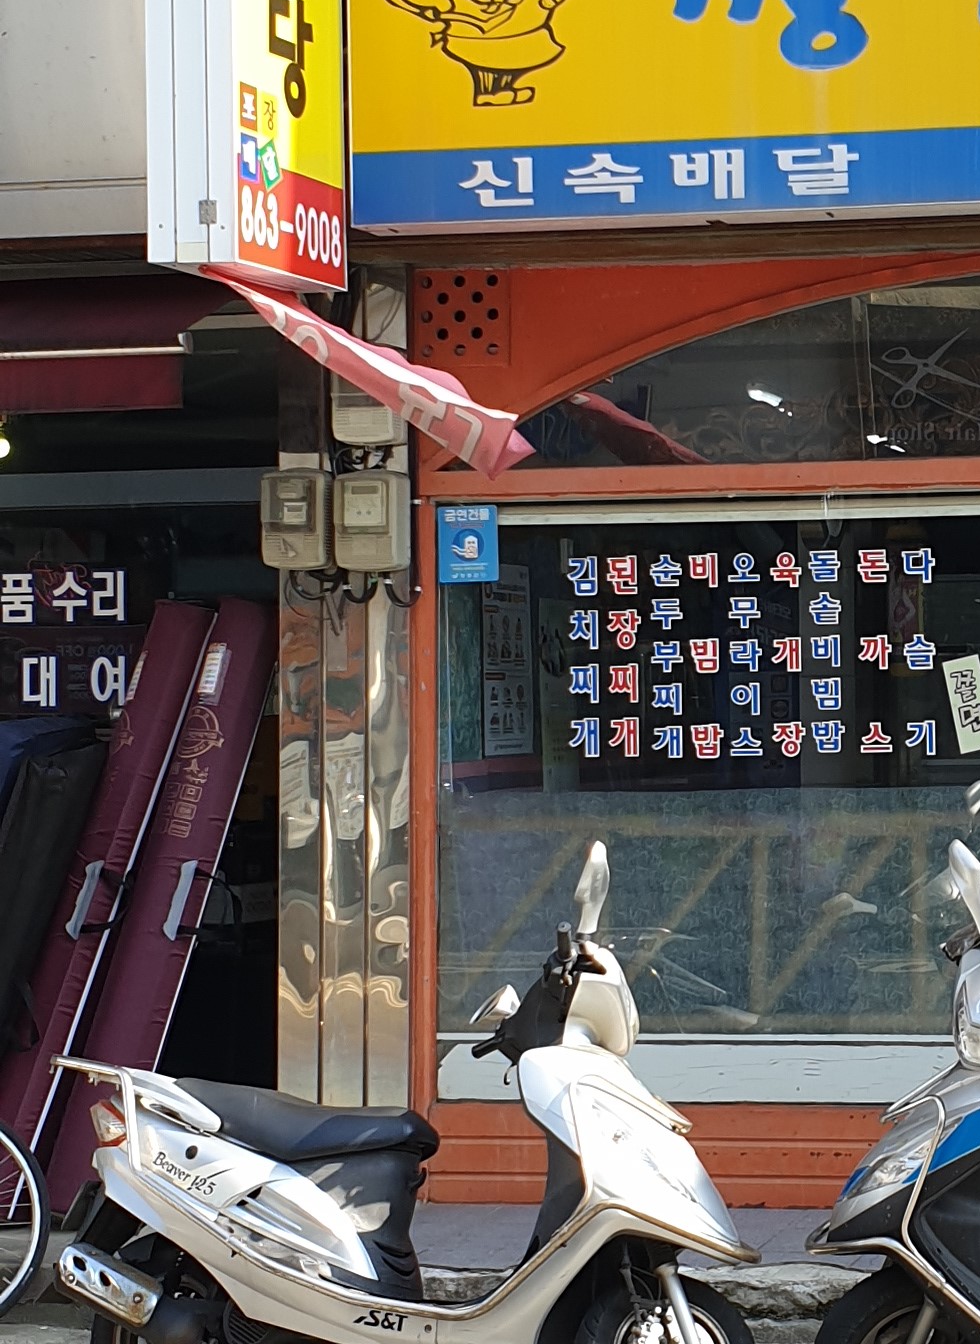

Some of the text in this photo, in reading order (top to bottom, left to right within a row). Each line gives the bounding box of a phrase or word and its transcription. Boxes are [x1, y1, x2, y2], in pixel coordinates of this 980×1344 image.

[241, 184, 341, 268] 863-9008
[458, 145, 860, 208] 신속배달
[1, 570, 125, 623] 품 수리
[567, 556, 600, 757] 김치찌개
[607, 554, 642, 757] 된장찌개
[650, 554, 684, 758] 순두부찌개
[688, 553, 724, 759] 비빔밥
[727, 552, 763, 757] 오무라이스
[770, 552, 806, 757] 육개장
[808, 549, 845, 754] 돌솥비빔밥
[857, 549, 893, 753] 돈까스
[901, 548, 937, 756] 다슬기
[153, 1151, 191, 1182] Beaver
[363, 1309, 409, 1332] S&T
